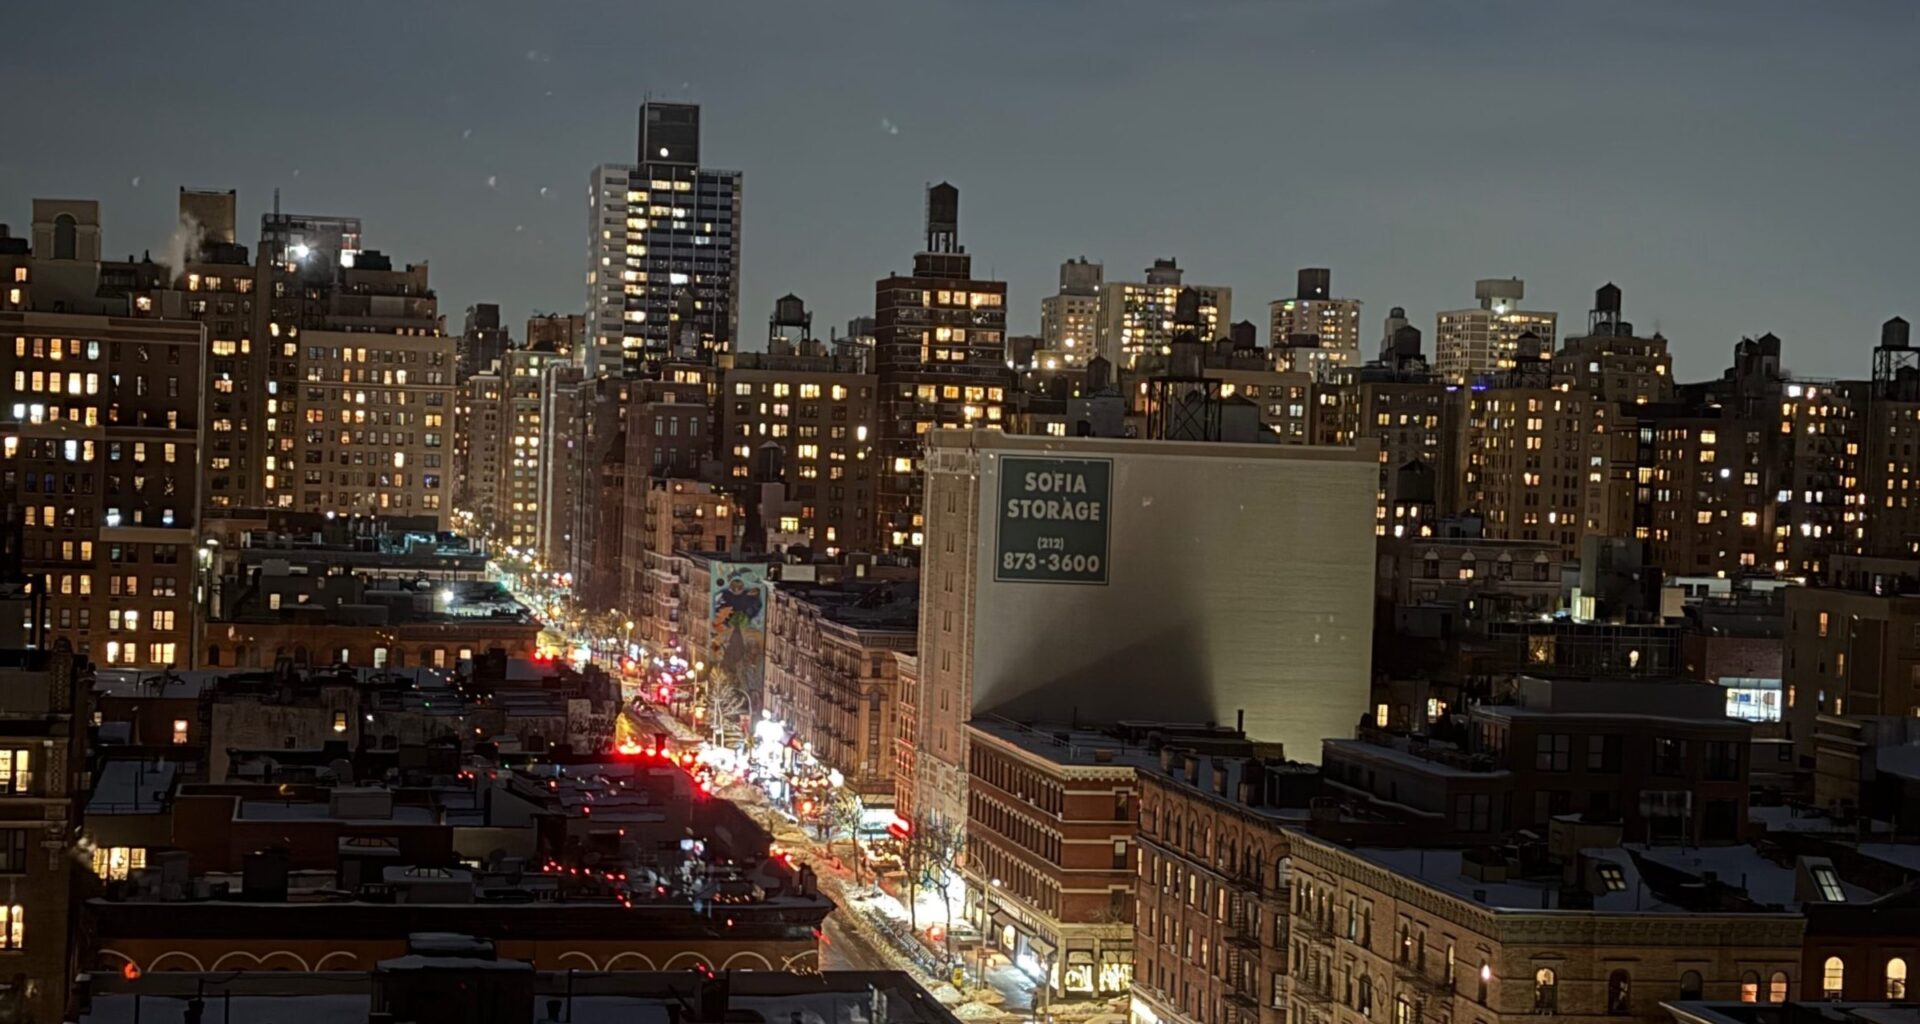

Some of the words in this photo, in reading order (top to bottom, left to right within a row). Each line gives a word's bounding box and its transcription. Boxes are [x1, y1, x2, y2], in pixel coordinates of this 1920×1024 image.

[1024, 471, 1087, 493] SOFIA
[1007, 499, 1100, 521] STORAGE
[1037, 536, 1064, 551] (212)
[1003, 552, 1099, 572] 873-3600
